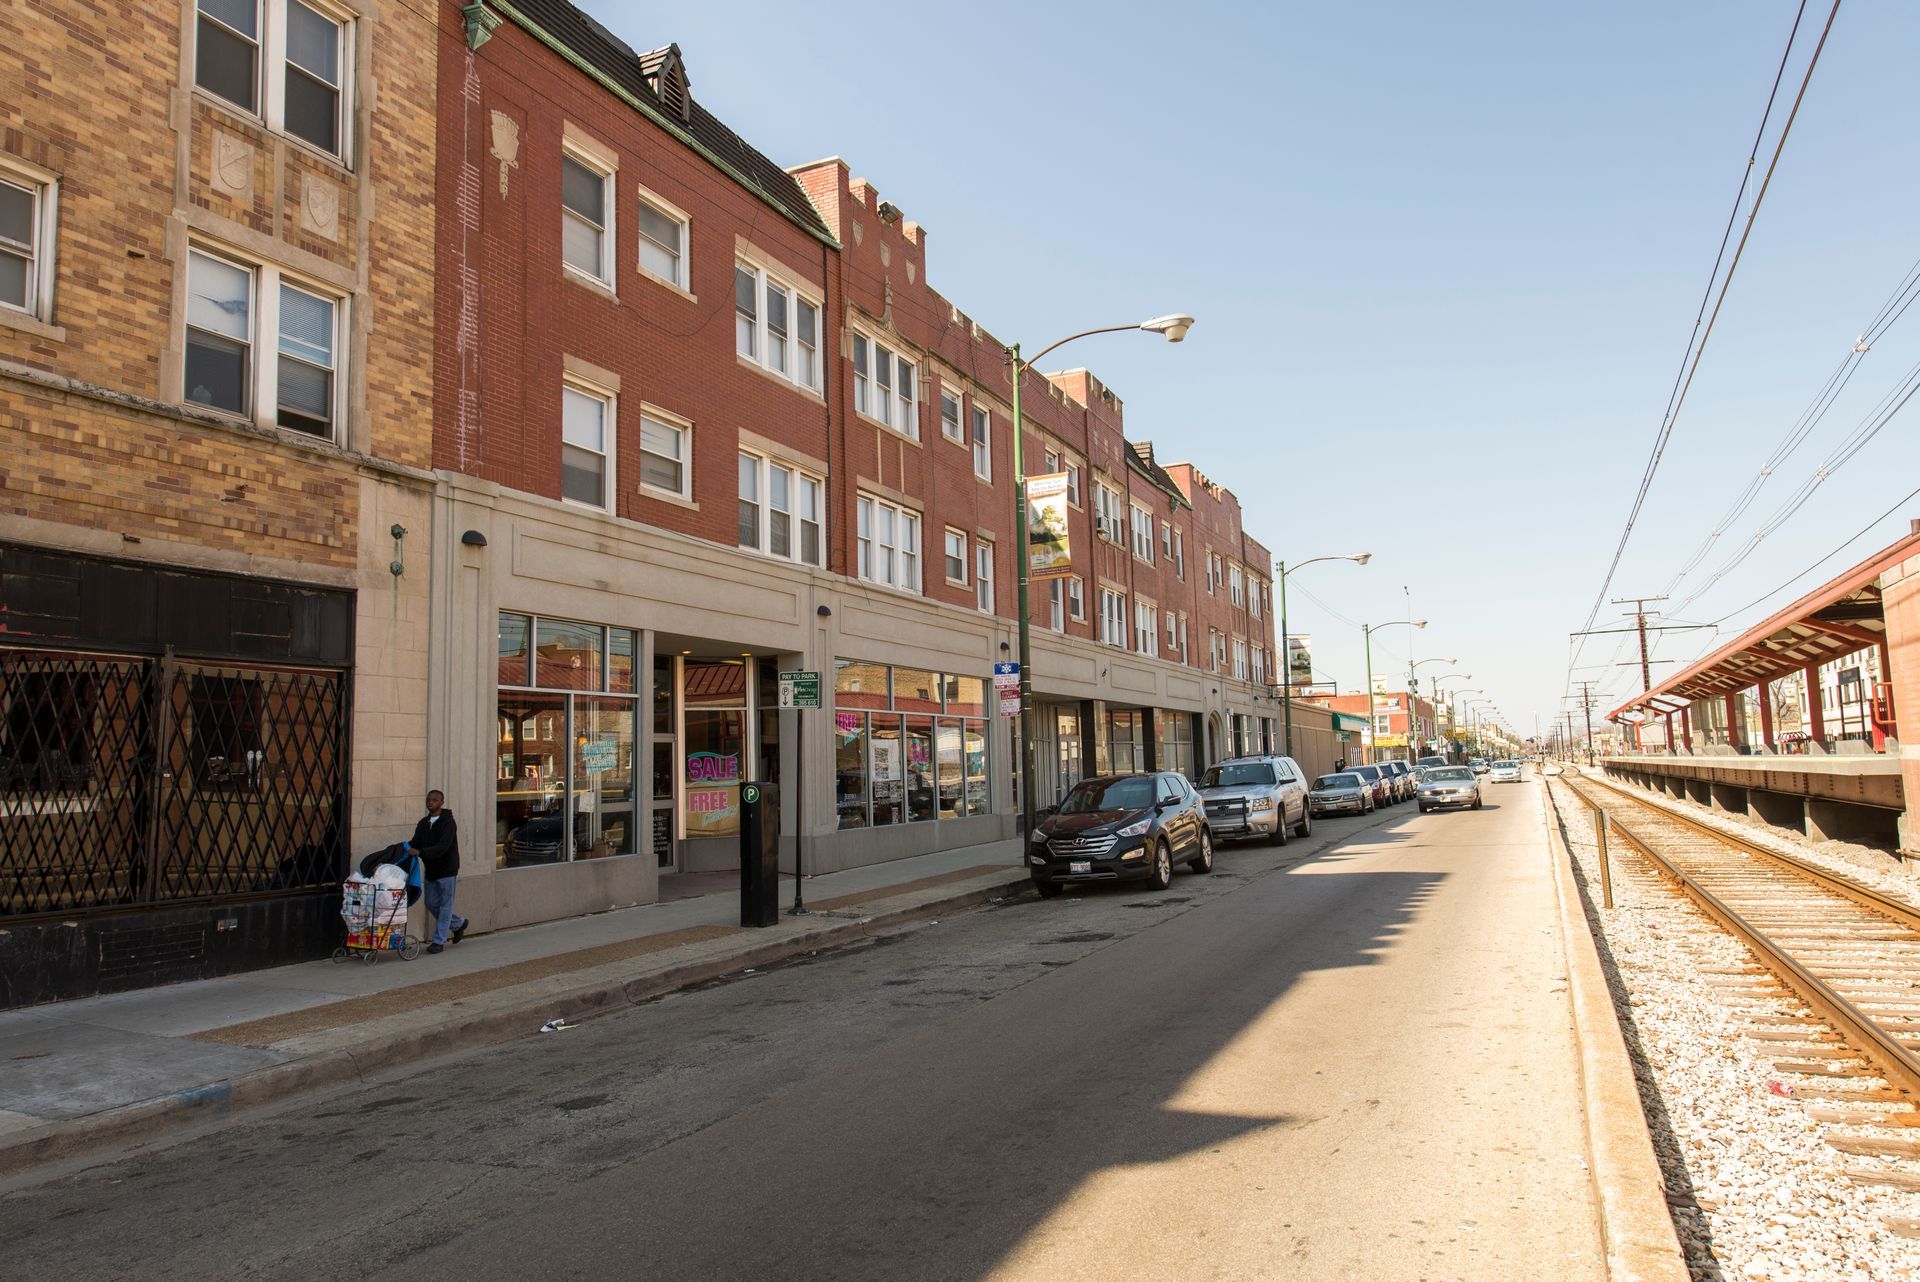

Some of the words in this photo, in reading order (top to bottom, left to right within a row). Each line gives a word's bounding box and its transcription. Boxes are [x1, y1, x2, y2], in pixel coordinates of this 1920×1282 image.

[689, 757, 738, 780] SALE
[689, 790, 728, 813] FREE
[747, 788, 755, 801] P
